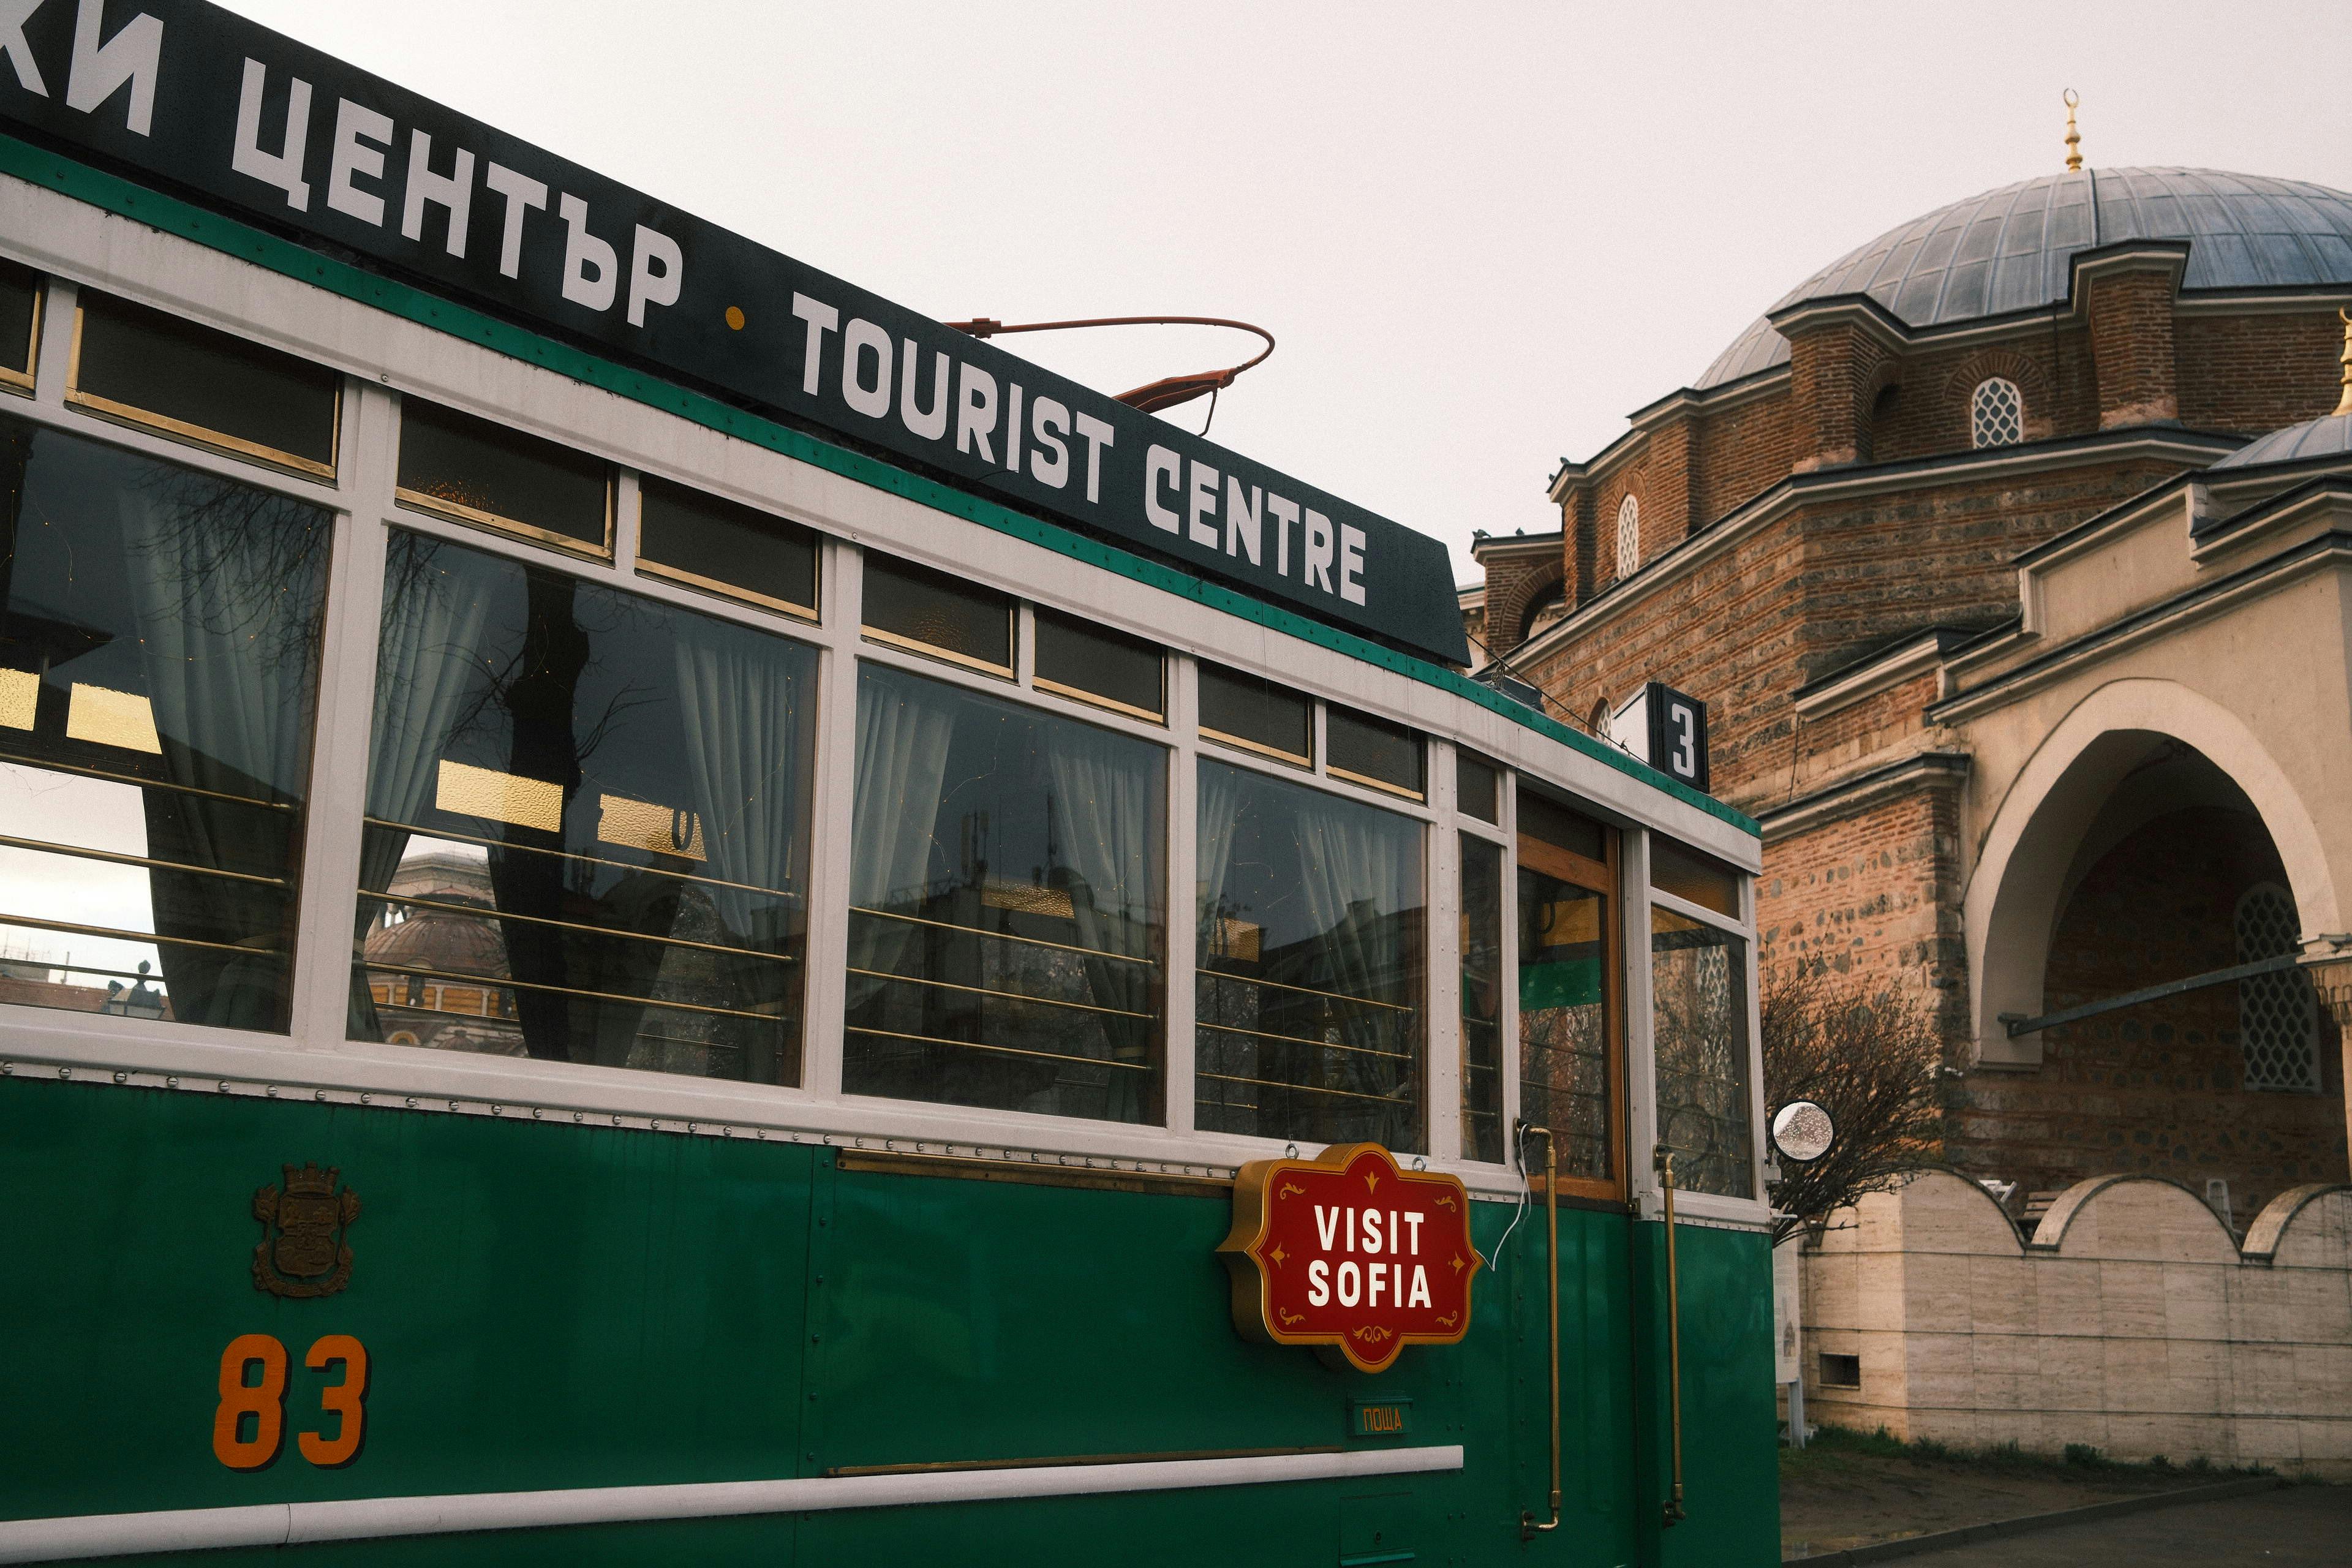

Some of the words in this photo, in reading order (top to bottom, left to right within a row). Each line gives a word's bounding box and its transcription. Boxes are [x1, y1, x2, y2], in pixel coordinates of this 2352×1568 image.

[232, 56, 683, 328] ЦЕНТЪР
[792, 291, 1114, 504] TOURIST
[1145, 443, 1366, 607] CENTRE
[1672, 703, 1695, 778] 3
[1314, 1205, 1424, 1255] VISIT
[1308, 1259, 1432, 1308] SOFIA
[213, 1334, 369, 1469] 83
[1363, 1407, 1403, 1432] ПОЩА
